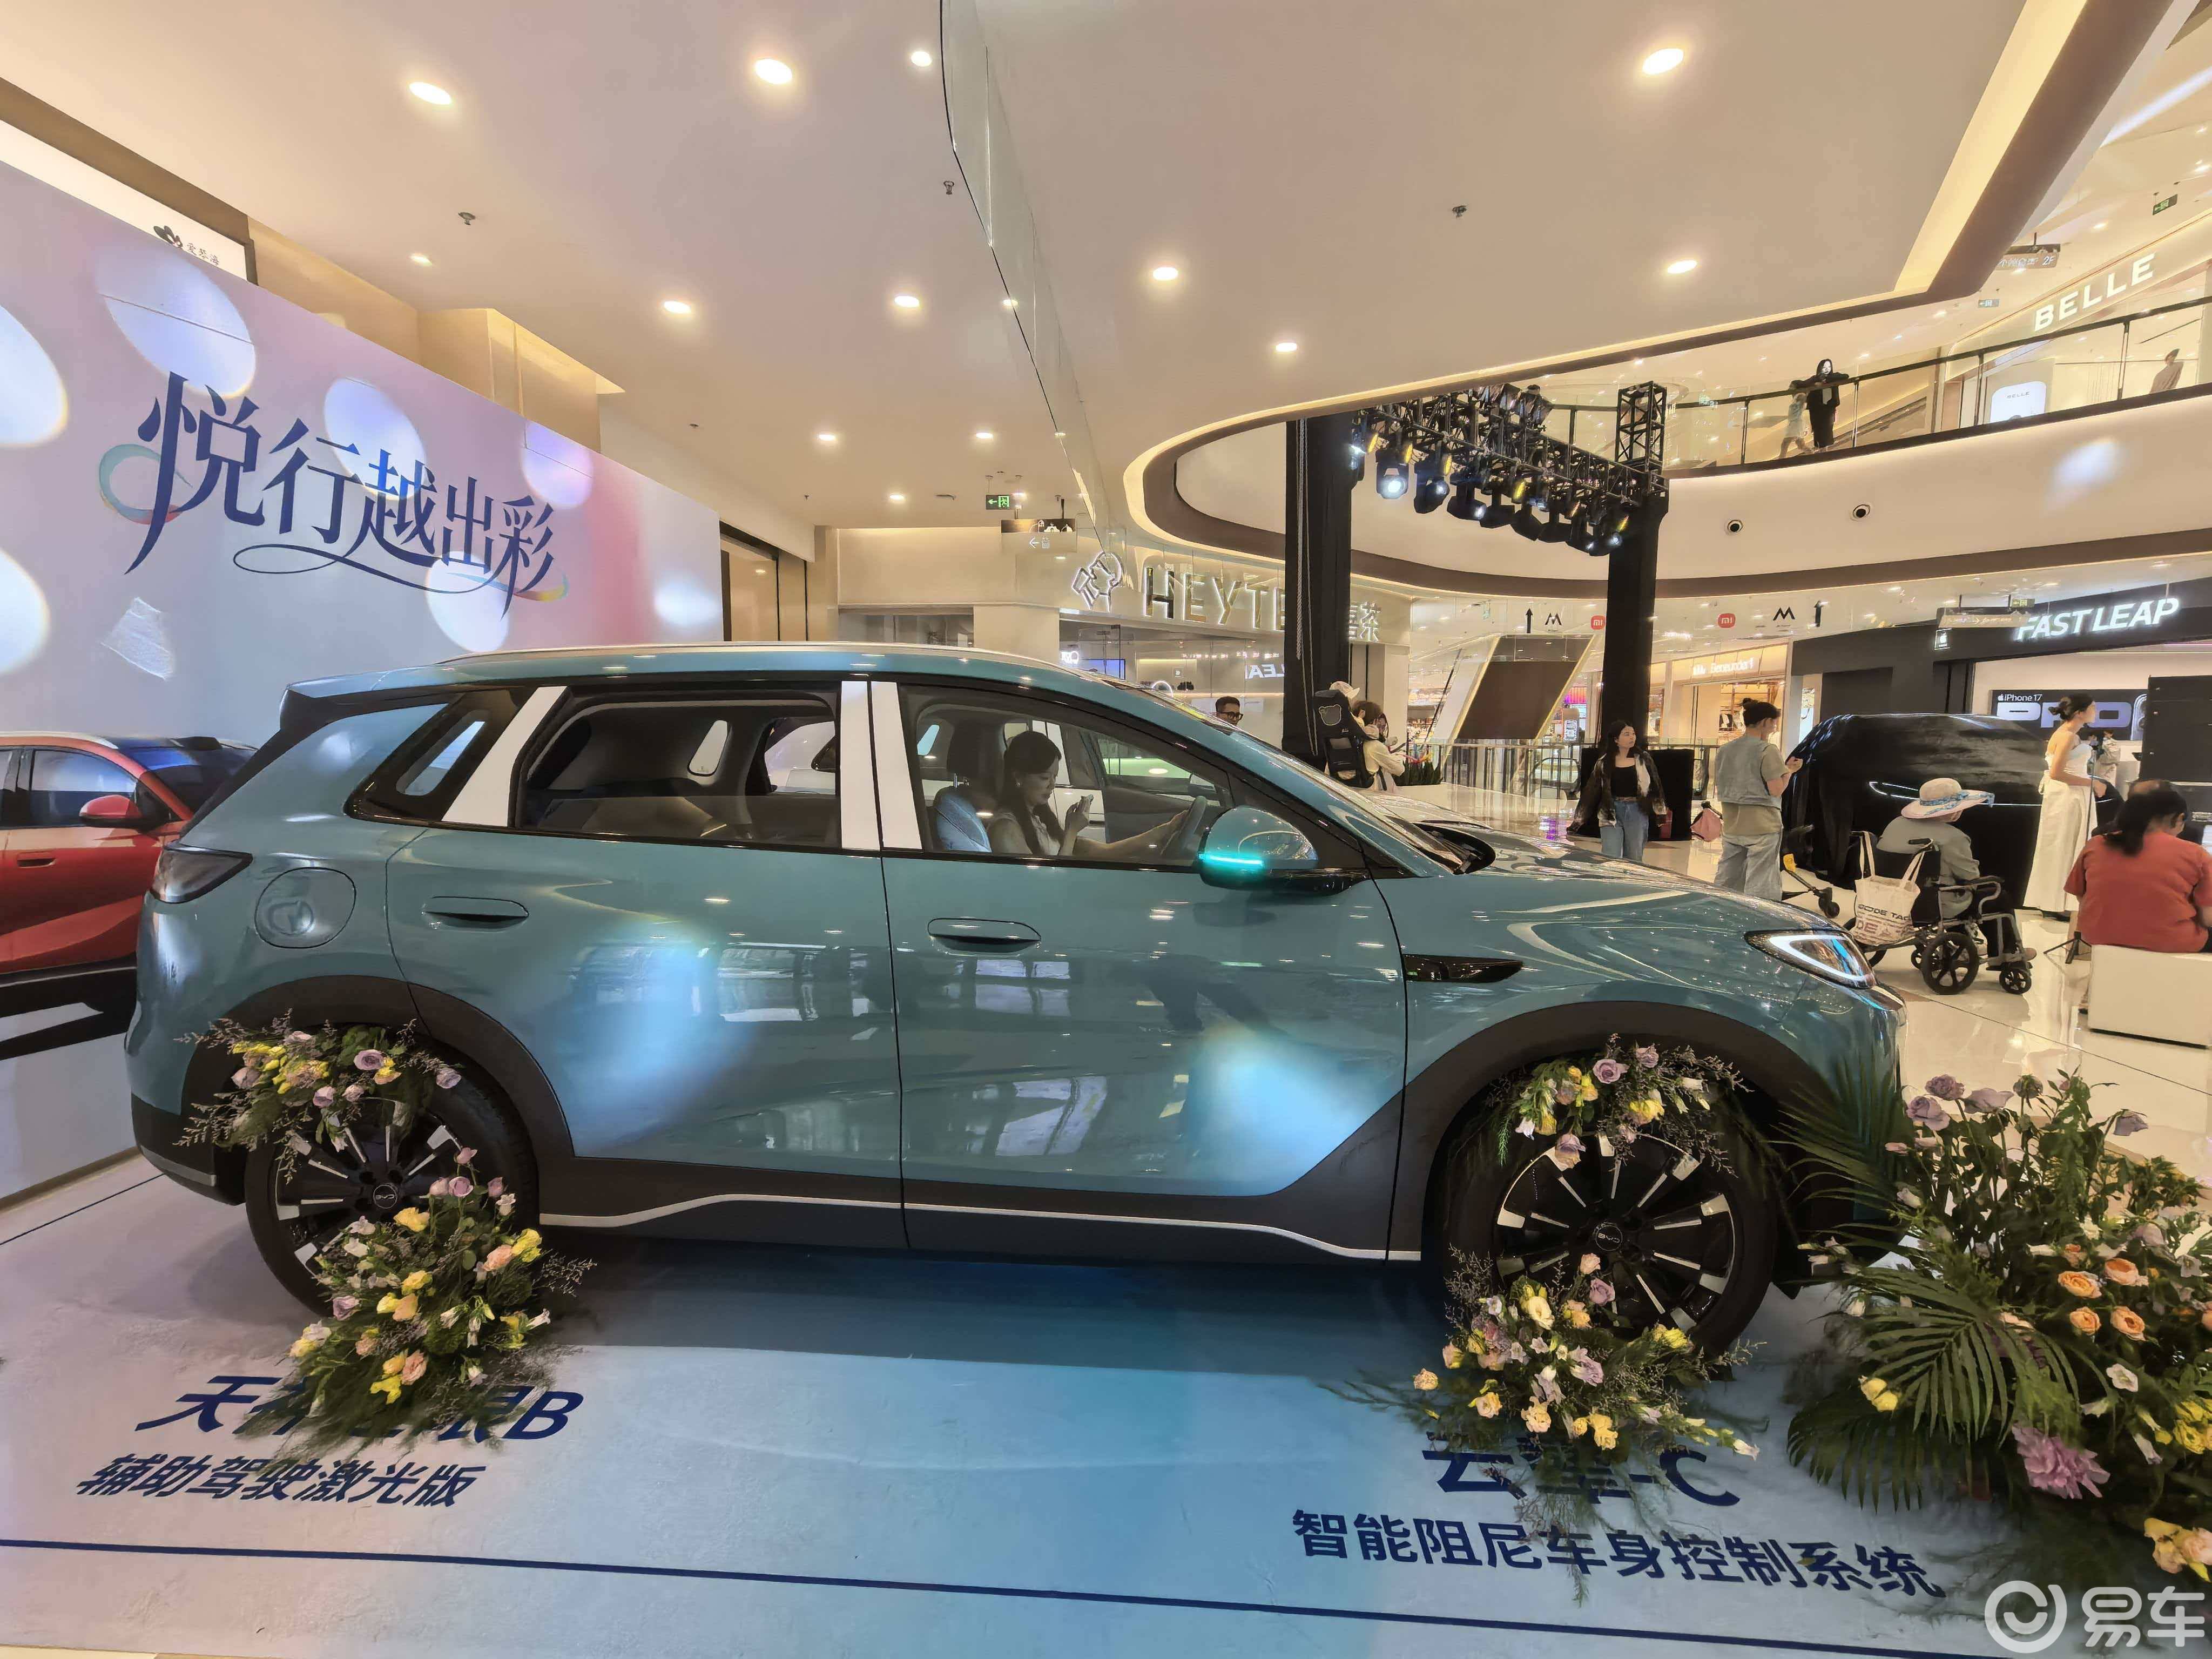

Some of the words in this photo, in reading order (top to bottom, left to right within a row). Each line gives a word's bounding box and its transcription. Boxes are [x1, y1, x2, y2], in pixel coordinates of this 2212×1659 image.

[2035, 252, 2156, 332] BELLE
[124, 372, 554, 619] 悦行越出彩
[77, 1453, 487, 1507] 辅助驾驶激光版
[1292, 1509, 1946, 1597] 智能阻尼车身控制系统
